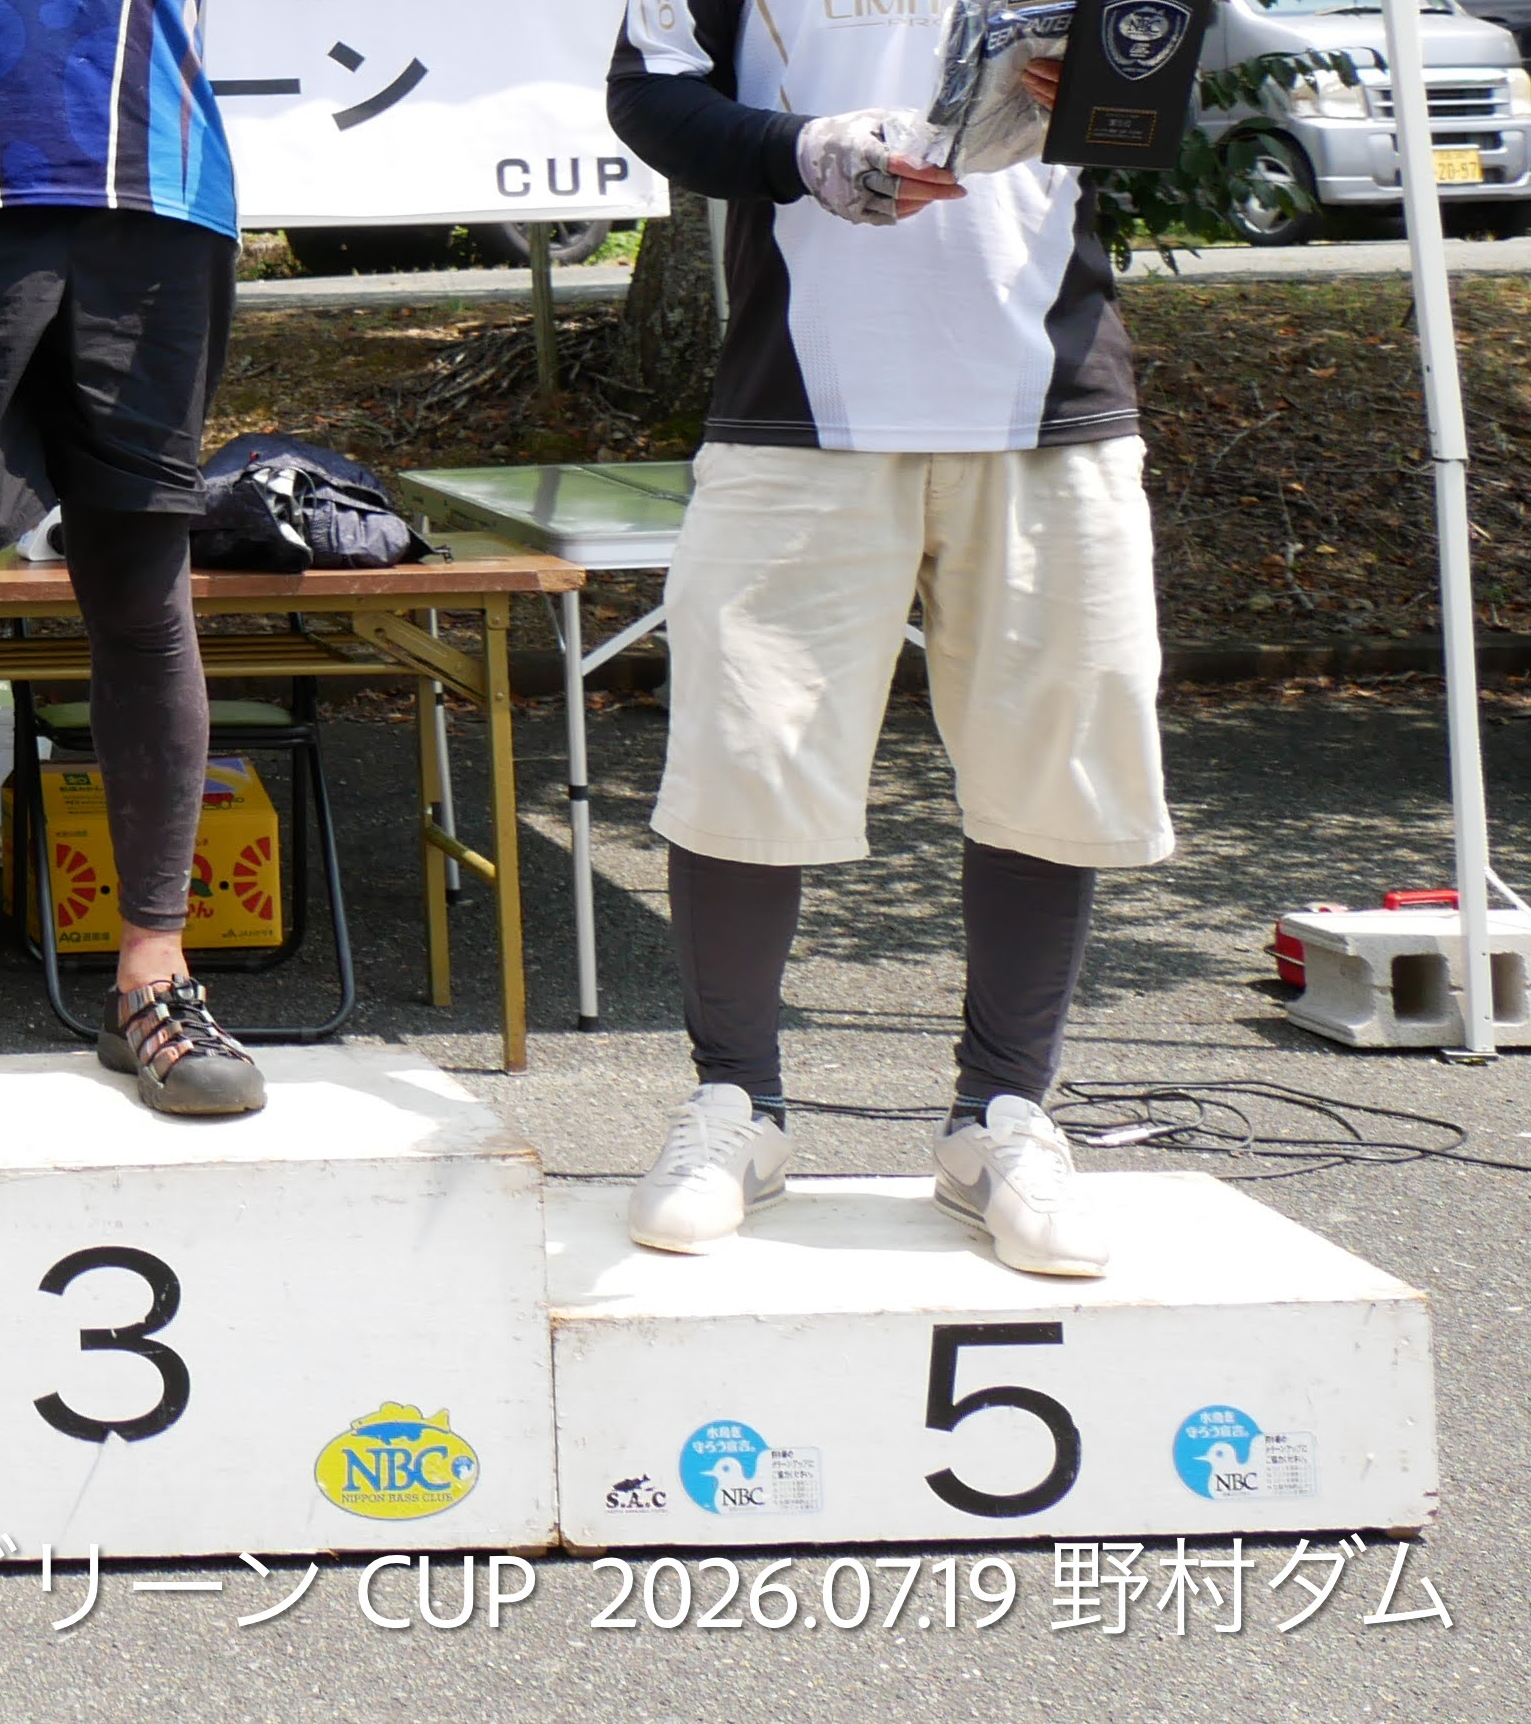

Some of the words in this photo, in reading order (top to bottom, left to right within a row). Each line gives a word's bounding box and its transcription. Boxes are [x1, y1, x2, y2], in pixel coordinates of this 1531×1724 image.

[496, 156, 631, 198] CUP
[33, 1246, 191, 1444] 3
[924, 1321, 1082, 1517] 5
[342, 1446, 451, 1491] NBC
[1215, 1473, 1259, 1492] NBC
[341, 1494, 385, 1503] NIPPON
[389, 1494, 419, 1503] BASS
[422, 1493, 453, 1502] CLUB
[605, 1491, 667, 1508] S.A.C
[721, 1487, 765, 1506] NBC
